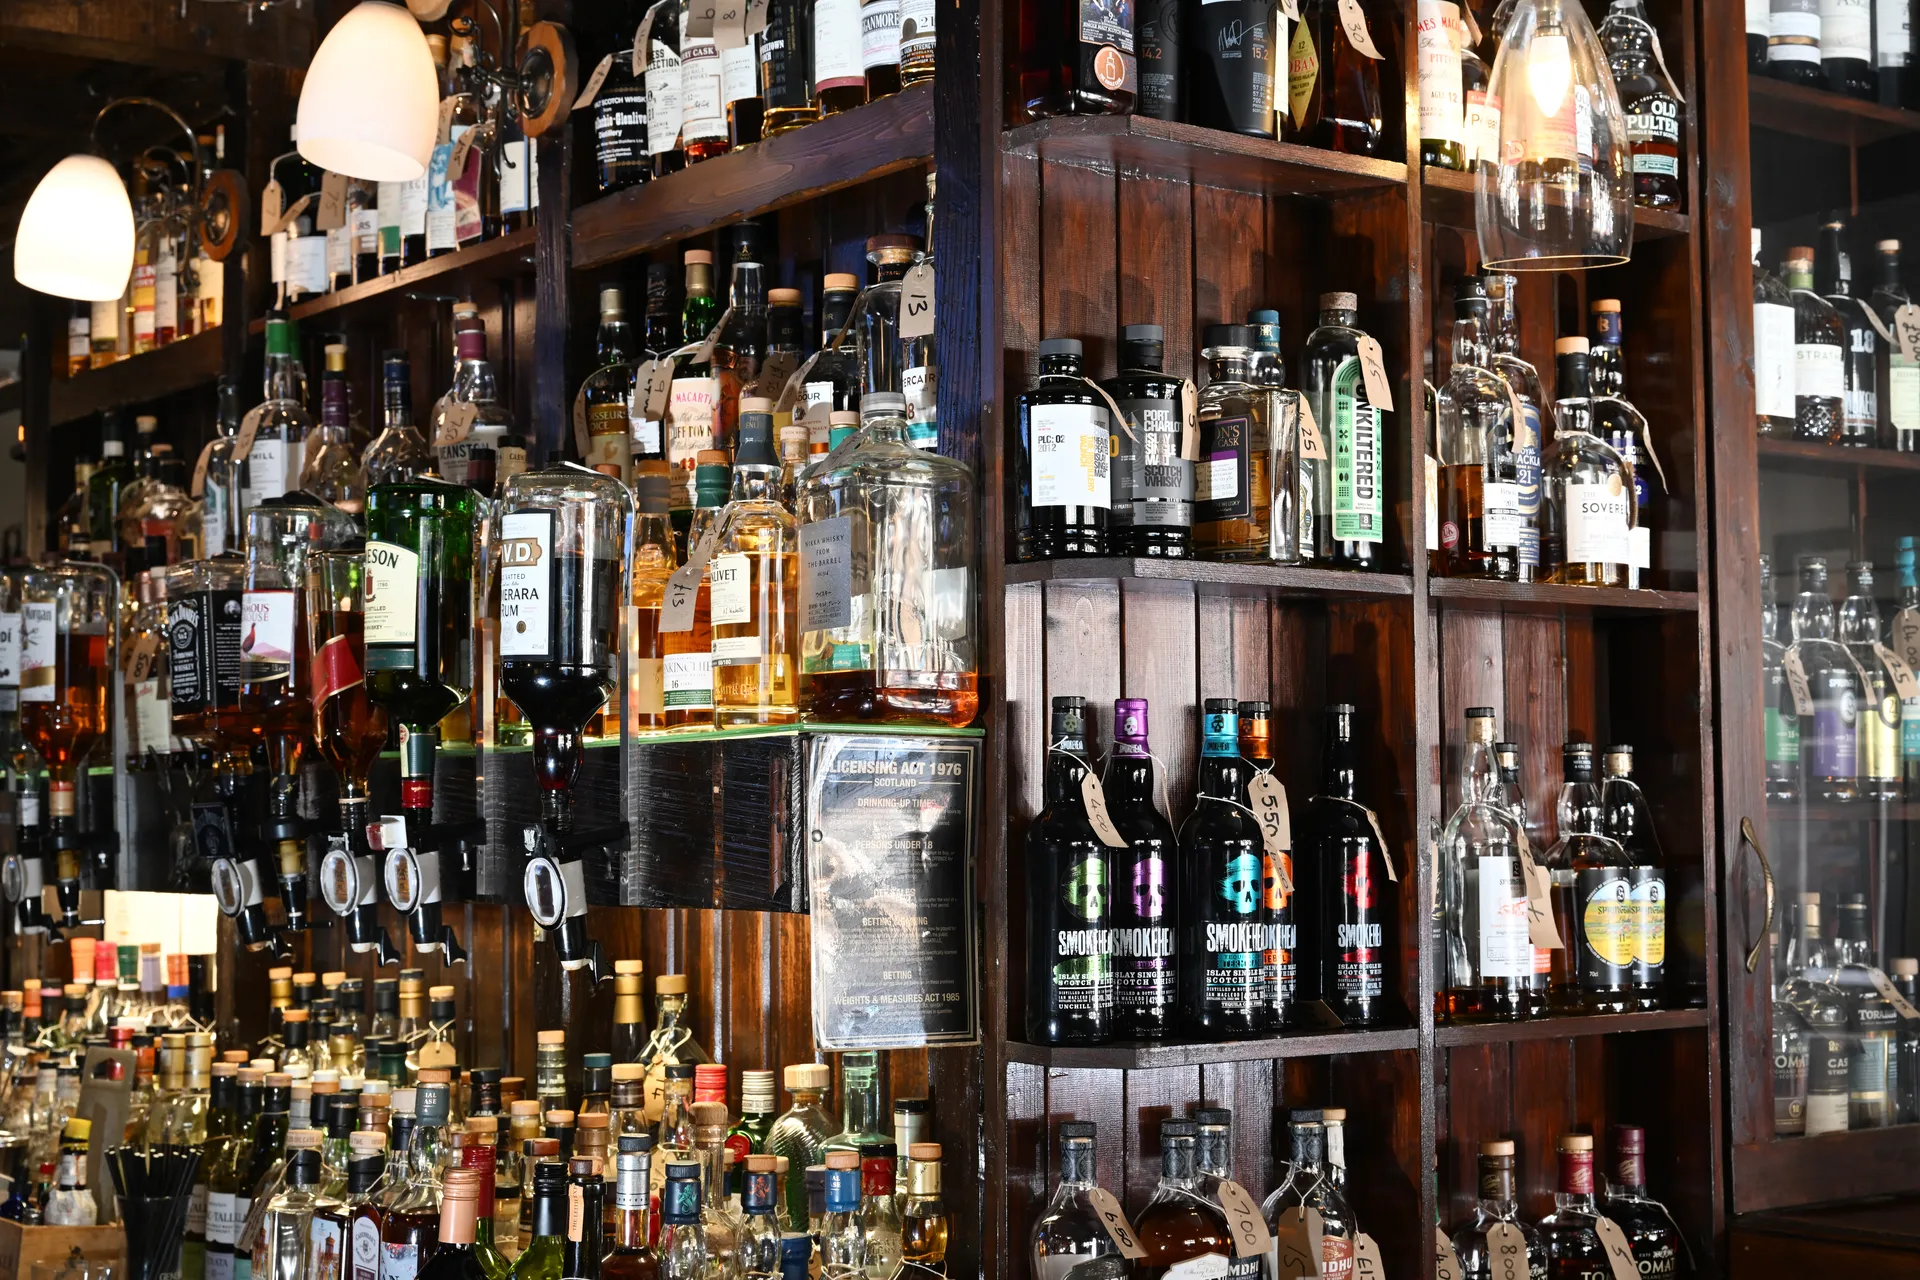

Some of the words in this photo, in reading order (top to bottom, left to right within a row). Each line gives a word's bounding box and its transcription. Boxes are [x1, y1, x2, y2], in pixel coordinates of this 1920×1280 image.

[692, 47, 714, 57] CASK
[1141, 47, 1162, 59] 14.2
[1252, 47, 1269, 61] 15.2
[1651, 100, 1676, 118] OLD
[908, 294, 928, 317] 13
[1850, 328, 1875, 353] 18
[1144, 409, 1170, 421] PORT
[1037, 436, 1054, 445] PLC:
[1145, 432, 1172, 444] ISLAY
[1354, 376, 1374, 501] UNKILTERED
[1037, 443, 1057, 453] 2012
[1145, 444, 1177, 456] SINGLE
[1145, 455, 1171, 466] MALT
[1144, 466, 1182, 477] SCOTCH
[1519, 470, 1532, 485] 21
[1144, 476, 1182, 488] WHISKY
[1582, 502, 1625, 515] SOVERE
[1363, 516, 1369, 525] 8
[822, 534, 844, 543] WHISKY
[815, 548, 830, 556] FROM
[808, 560, 818, 569] THE
[819, 557, 842, 568] BARREL
[671, 680, 679, 689] 16
[830, 760, 898, 775] LICENSING
[900, 762, 925, 776] ACT
[929, 762, 961, 776] 1976
[873, 777, 917, 788] SCOTLAND
[857, 798, 910, 808] DRINKING-UP
[894, 840, 921, 850] UNDER
[923, 840, 933, 849] 18
[883, 970, 912, 980] BETTING
[1206, 969, 1231, 977] ISLAY
[1206, 976, 1244, 984] SCOTCH
[834, 995, 871, 1006] WEIGHTS
[881, 994, 924, 1004] MEASURES
[925, 993, 940, 1002] ACT
[1827, 1057, 1849, 1069] CAS
